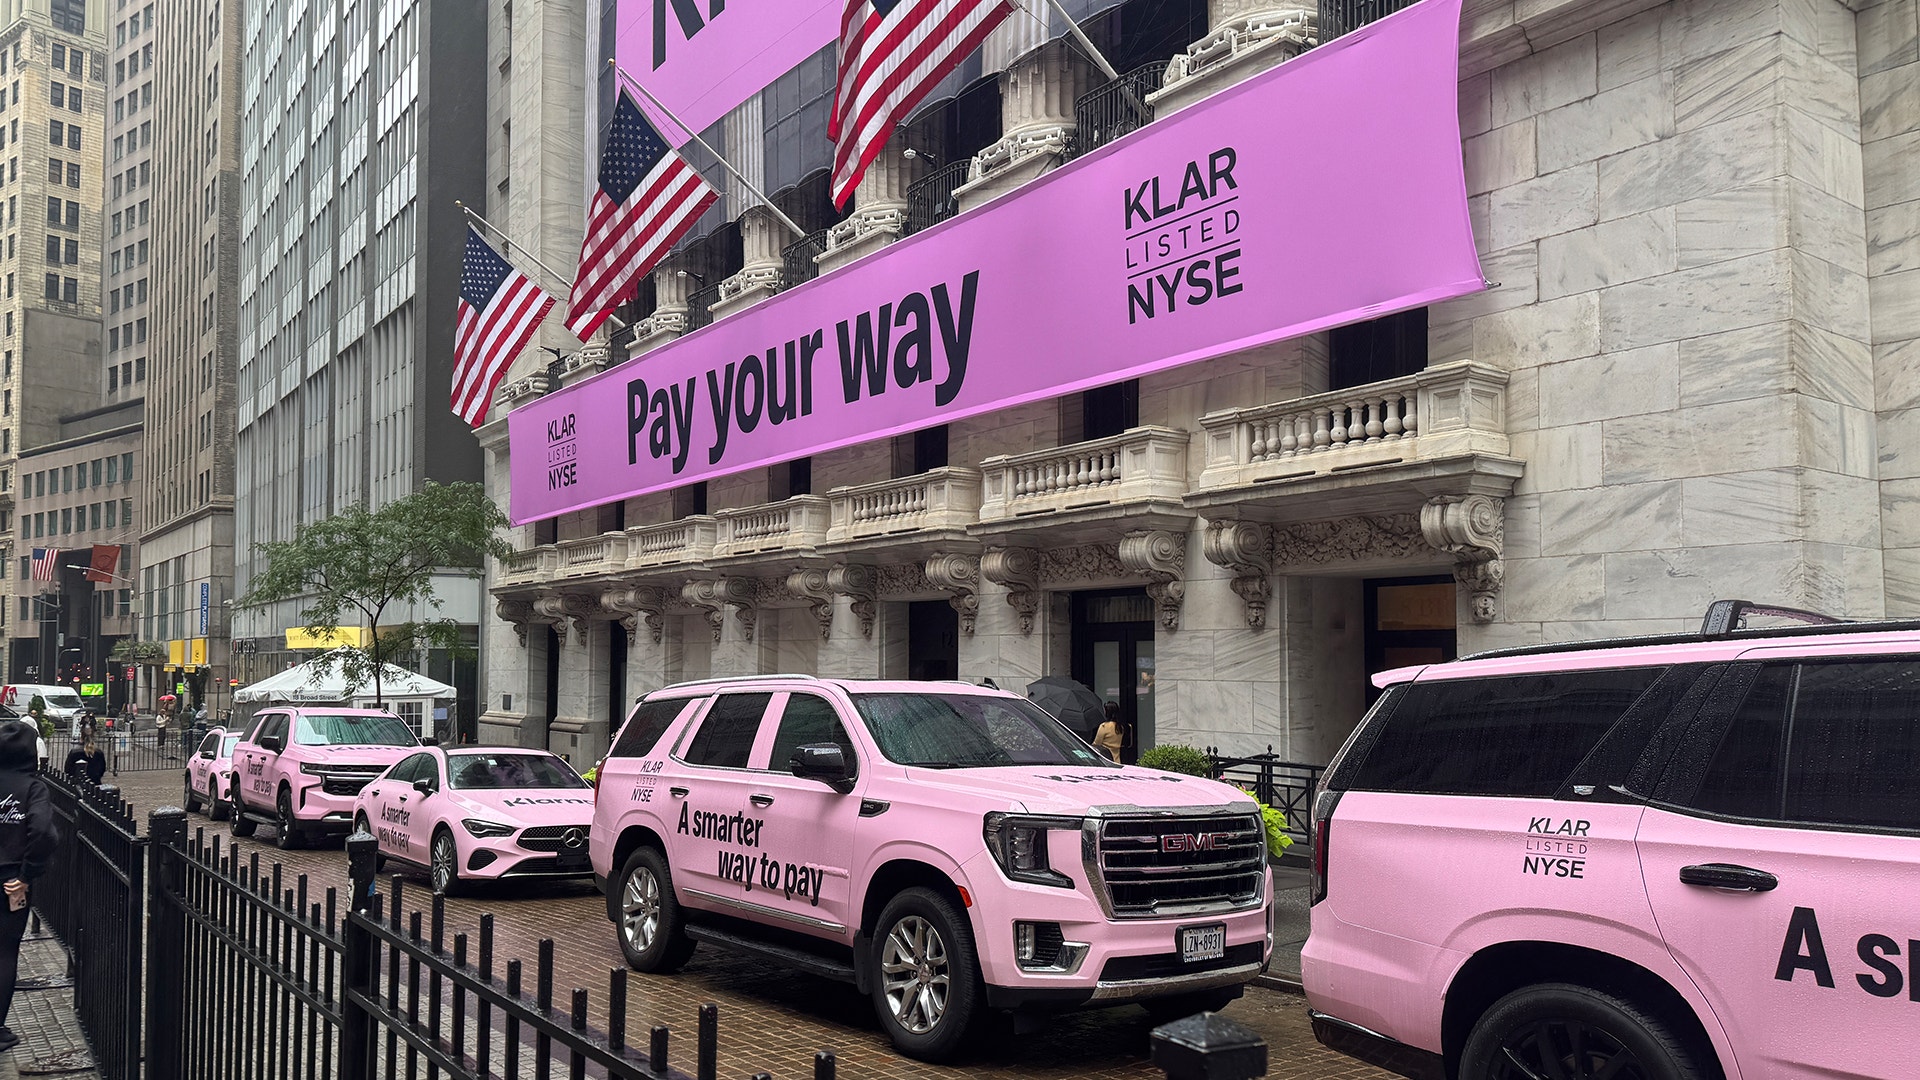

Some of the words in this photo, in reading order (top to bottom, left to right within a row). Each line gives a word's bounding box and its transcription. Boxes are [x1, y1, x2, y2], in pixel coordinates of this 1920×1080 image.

[1124, 147, 1238, 230] KLAR
[1126, 209, 1240, 269] LISTED
[1127, 248, 1243, 324] NYSE
[626, 375, 696, 475] Pay
[707, 328, 822, 465] your
[836, 269, 980, 407] way
[547, 413, 576, 442] KLAR
[547, 442, 577, 464] LISTED
[547, 461, 577, 491] NYSE
[636, 776, 657, 785] LISTED
[640, 760, 664, 774] KLAR
[631, 788, 653, 802] NYSE
[381, 801, 386, 820] A
[386, 807, 411, 827] smarter
[677, 801, 690, 836] A
[692, 810, 764, 848] smarter
[1528, 817, 1591, 838] KLAR
[378, 826, 390, 847] way
[390, 827, 397, 846] to
[397, 832, 410, 853] pay
[1161, 832, 1229, 853] GMC
[1525, 840, 1588, 855] LISTED
[718, 850, 757, 893] way
[759, 852, 781, 890] to
[784, 863, 823, 907] pay
[1522, 857, 1585, 880] NYSE
[1774, 906, 1836, 989] A
